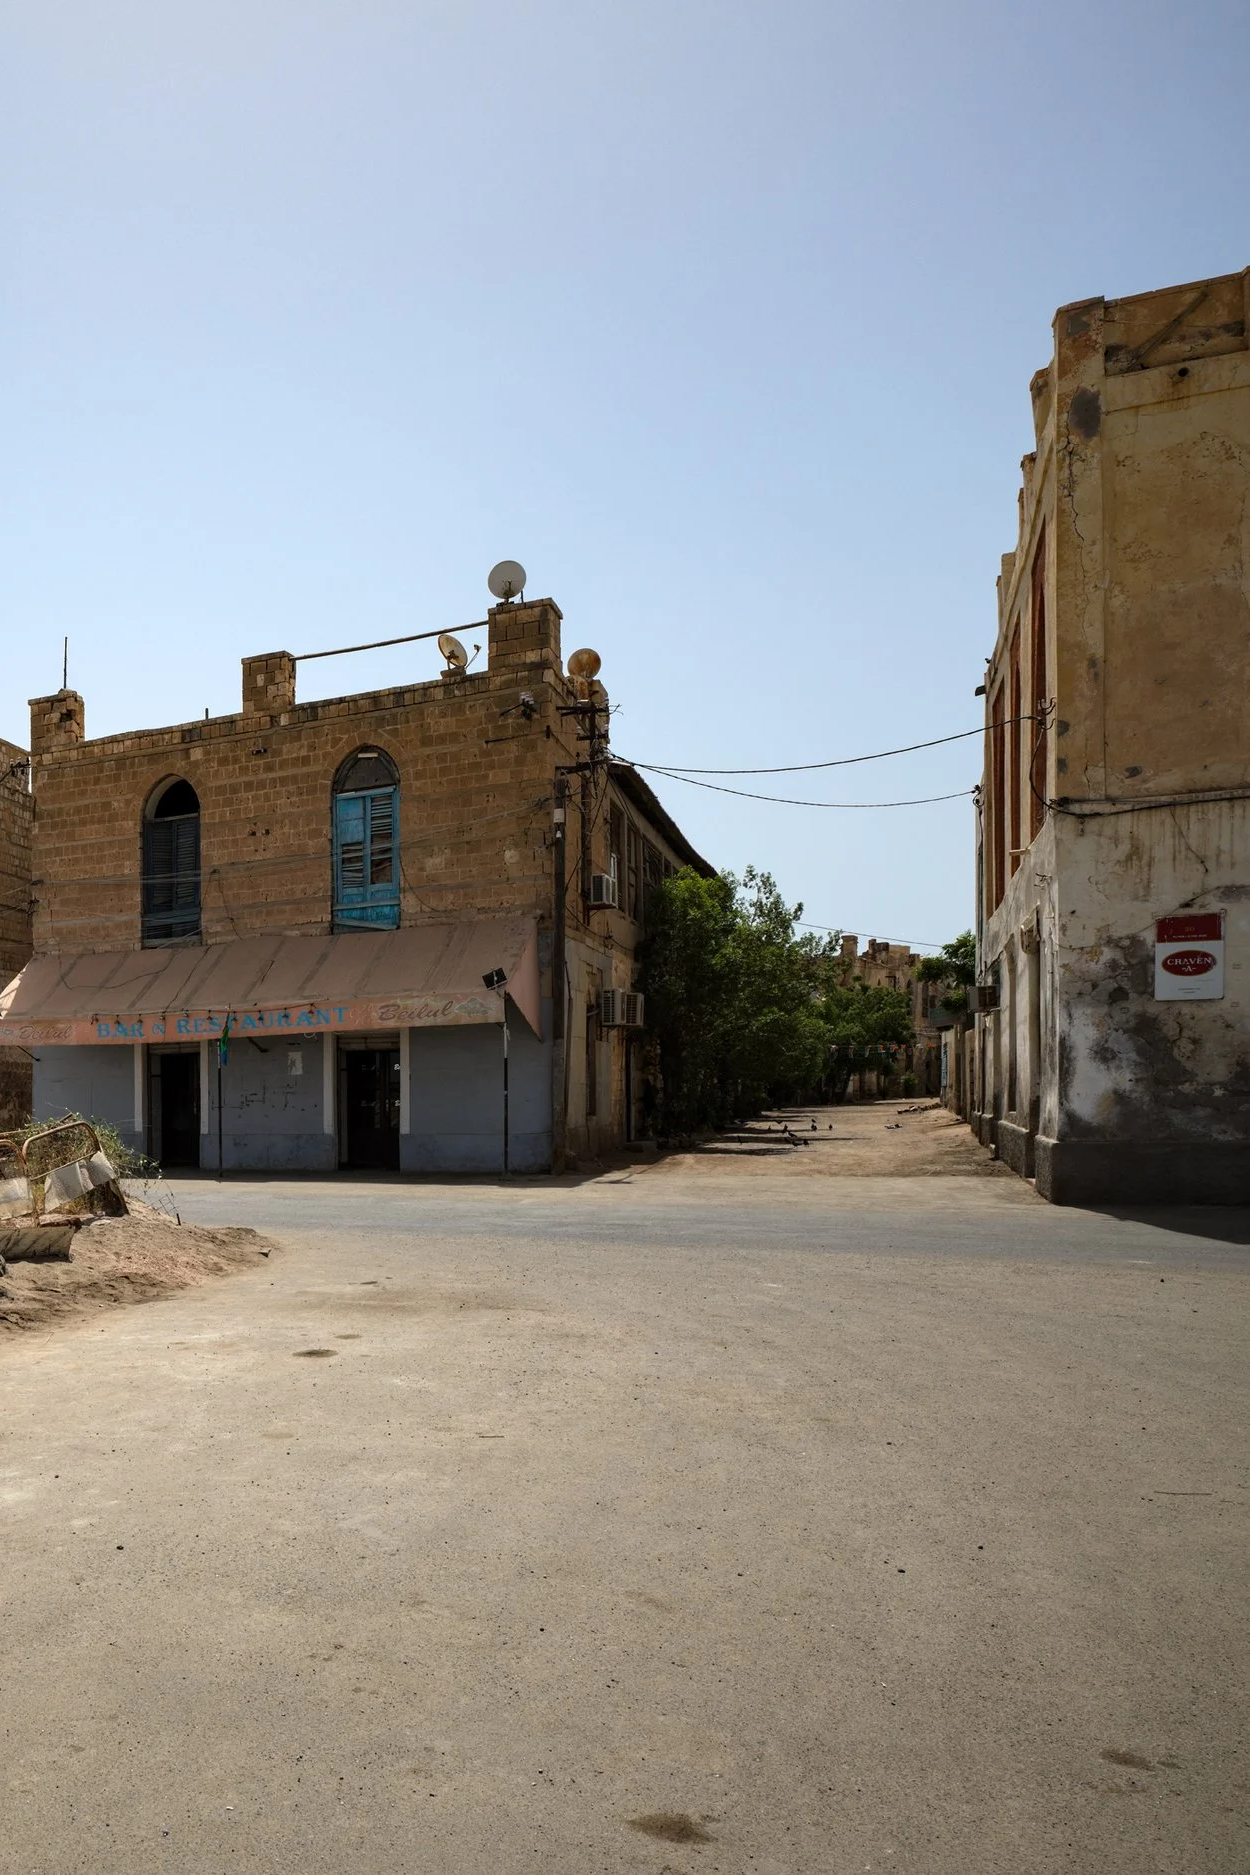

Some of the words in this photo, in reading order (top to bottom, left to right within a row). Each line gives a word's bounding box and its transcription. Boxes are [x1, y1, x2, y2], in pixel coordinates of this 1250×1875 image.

[1167, 957, 1212, 966] CRAVEN
[378, 1001, 453, 1020] Beilul
[96, 1023, 146, 1039] BAR
[177, 1007, 349, 1034] RESTAURANT
